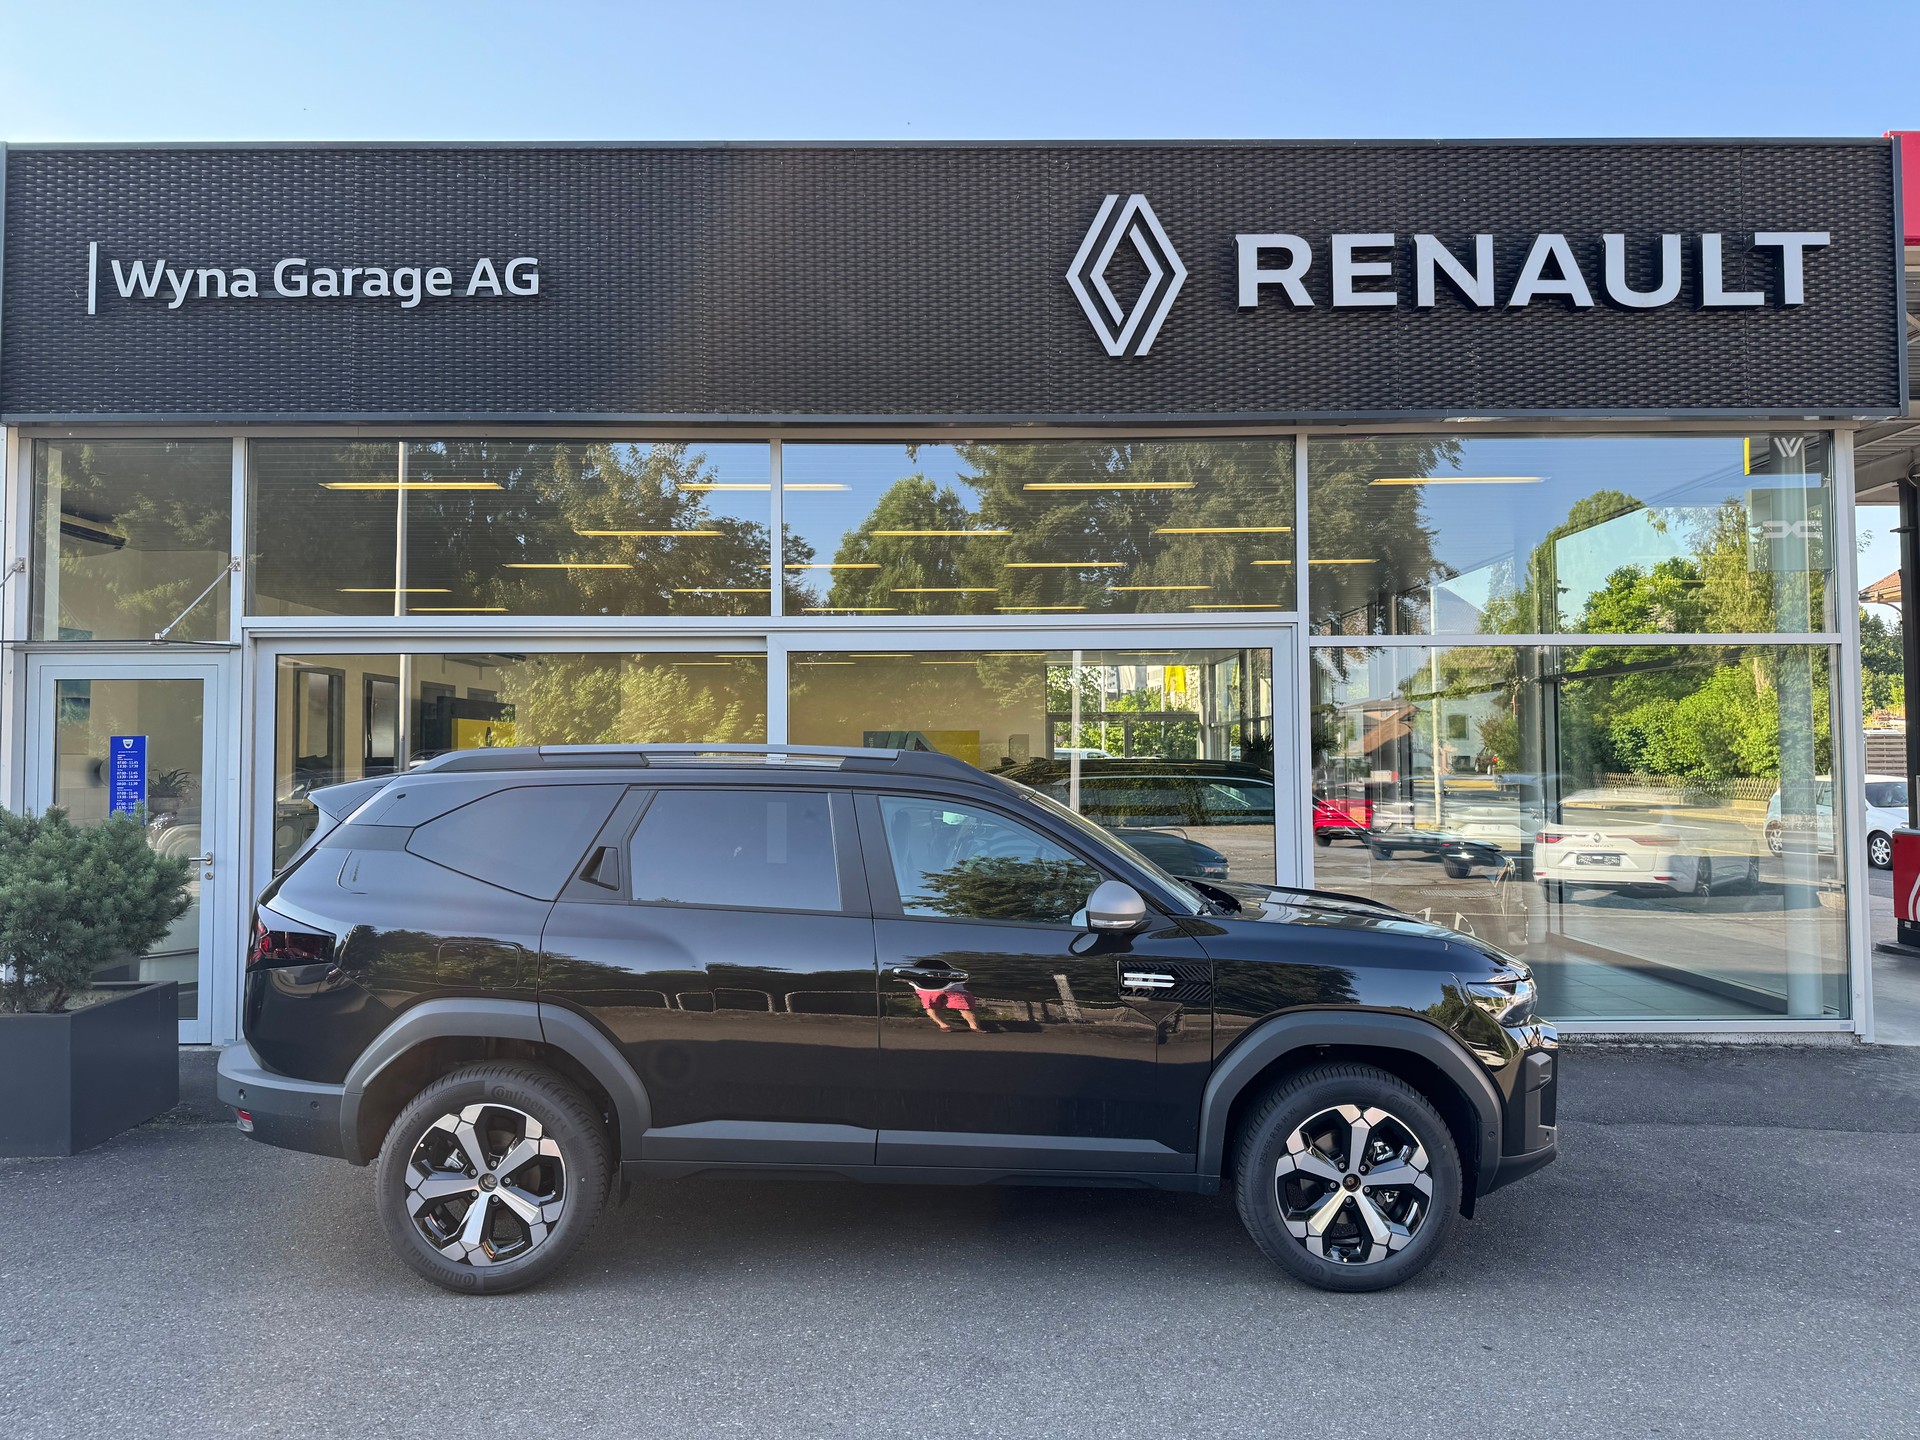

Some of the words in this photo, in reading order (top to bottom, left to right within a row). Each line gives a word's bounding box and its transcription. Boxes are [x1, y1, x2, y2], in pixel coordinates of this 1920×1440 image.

[111, 259, 258, 309] Wyna
[273, 258, 452, 308] Garage
[466, 257, 540, 296] AG
[1235, 231, 1831, 308] RENAULT
[491, 1086, 562, 1123] Continental
